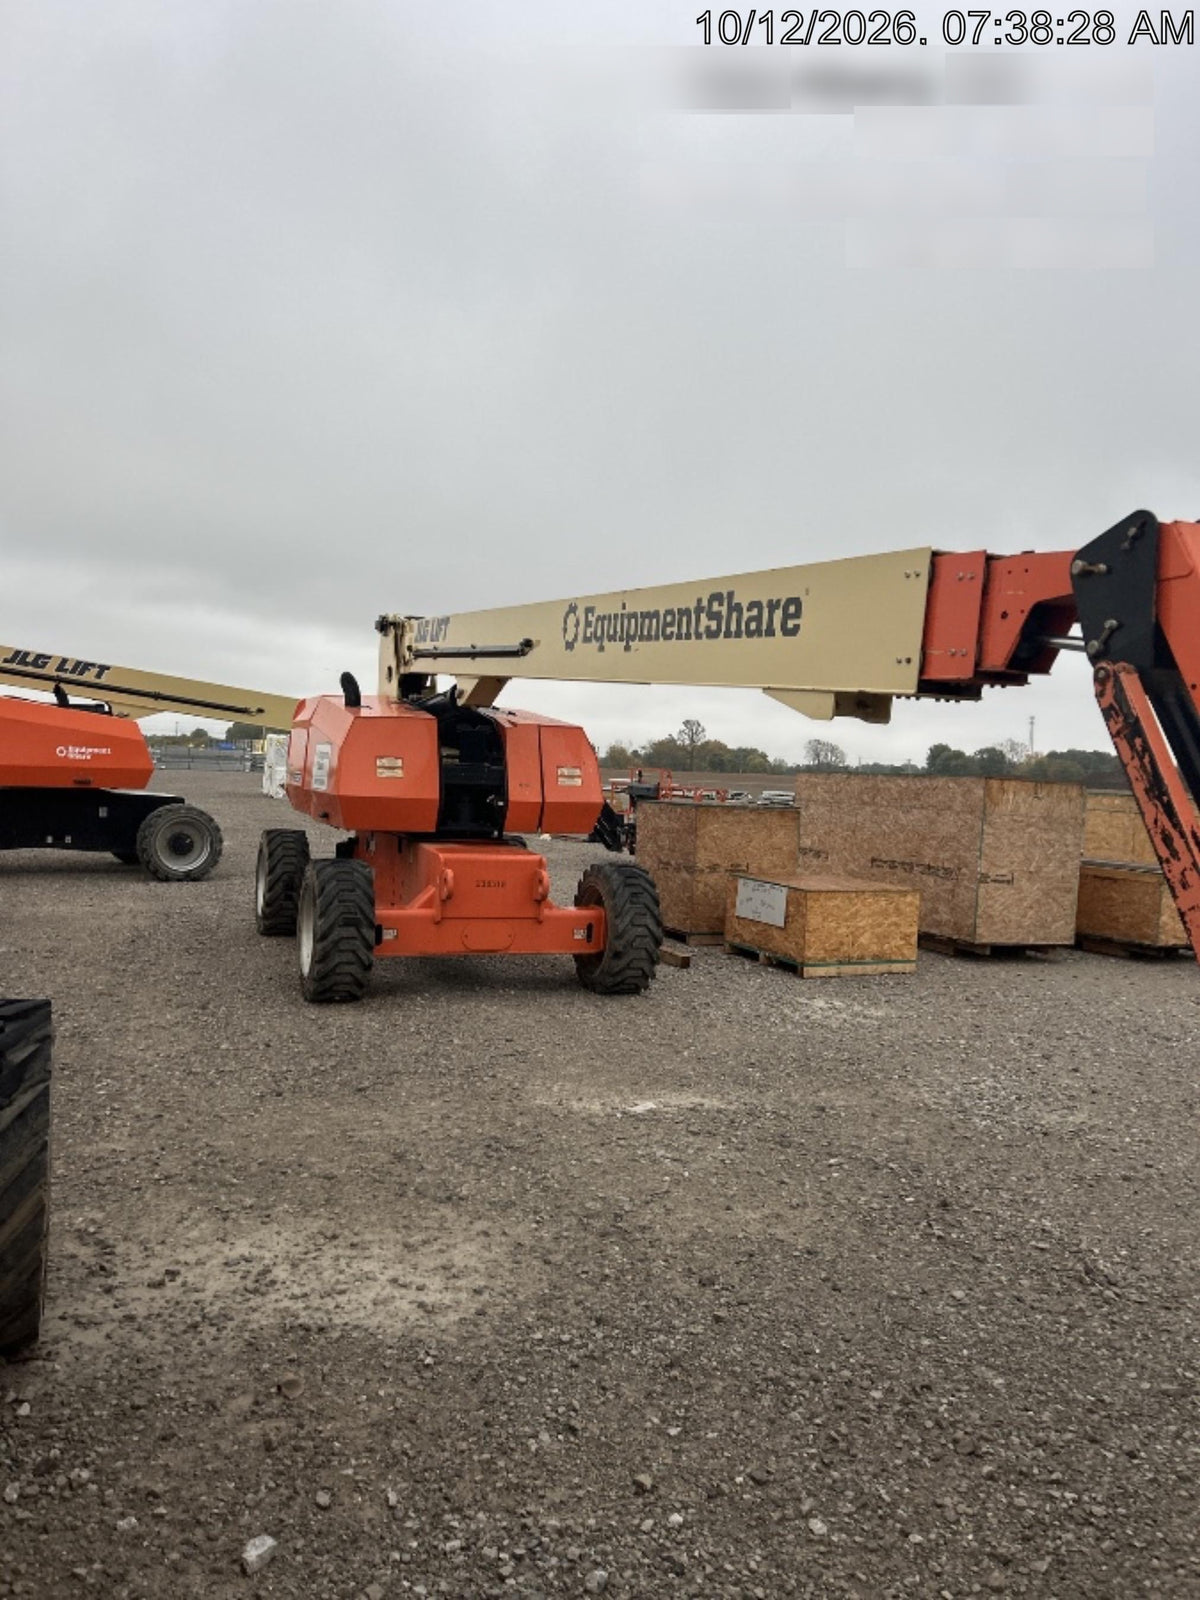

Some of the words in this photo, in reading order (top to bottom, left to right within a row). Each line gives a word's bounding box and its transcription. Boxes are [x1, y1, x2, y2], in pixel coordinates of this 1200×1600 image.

[582, 590, 803, 652] EquipmentShare
[2, 649, 53, 669] JLG
[55, 656, 112, 679] LIFT
